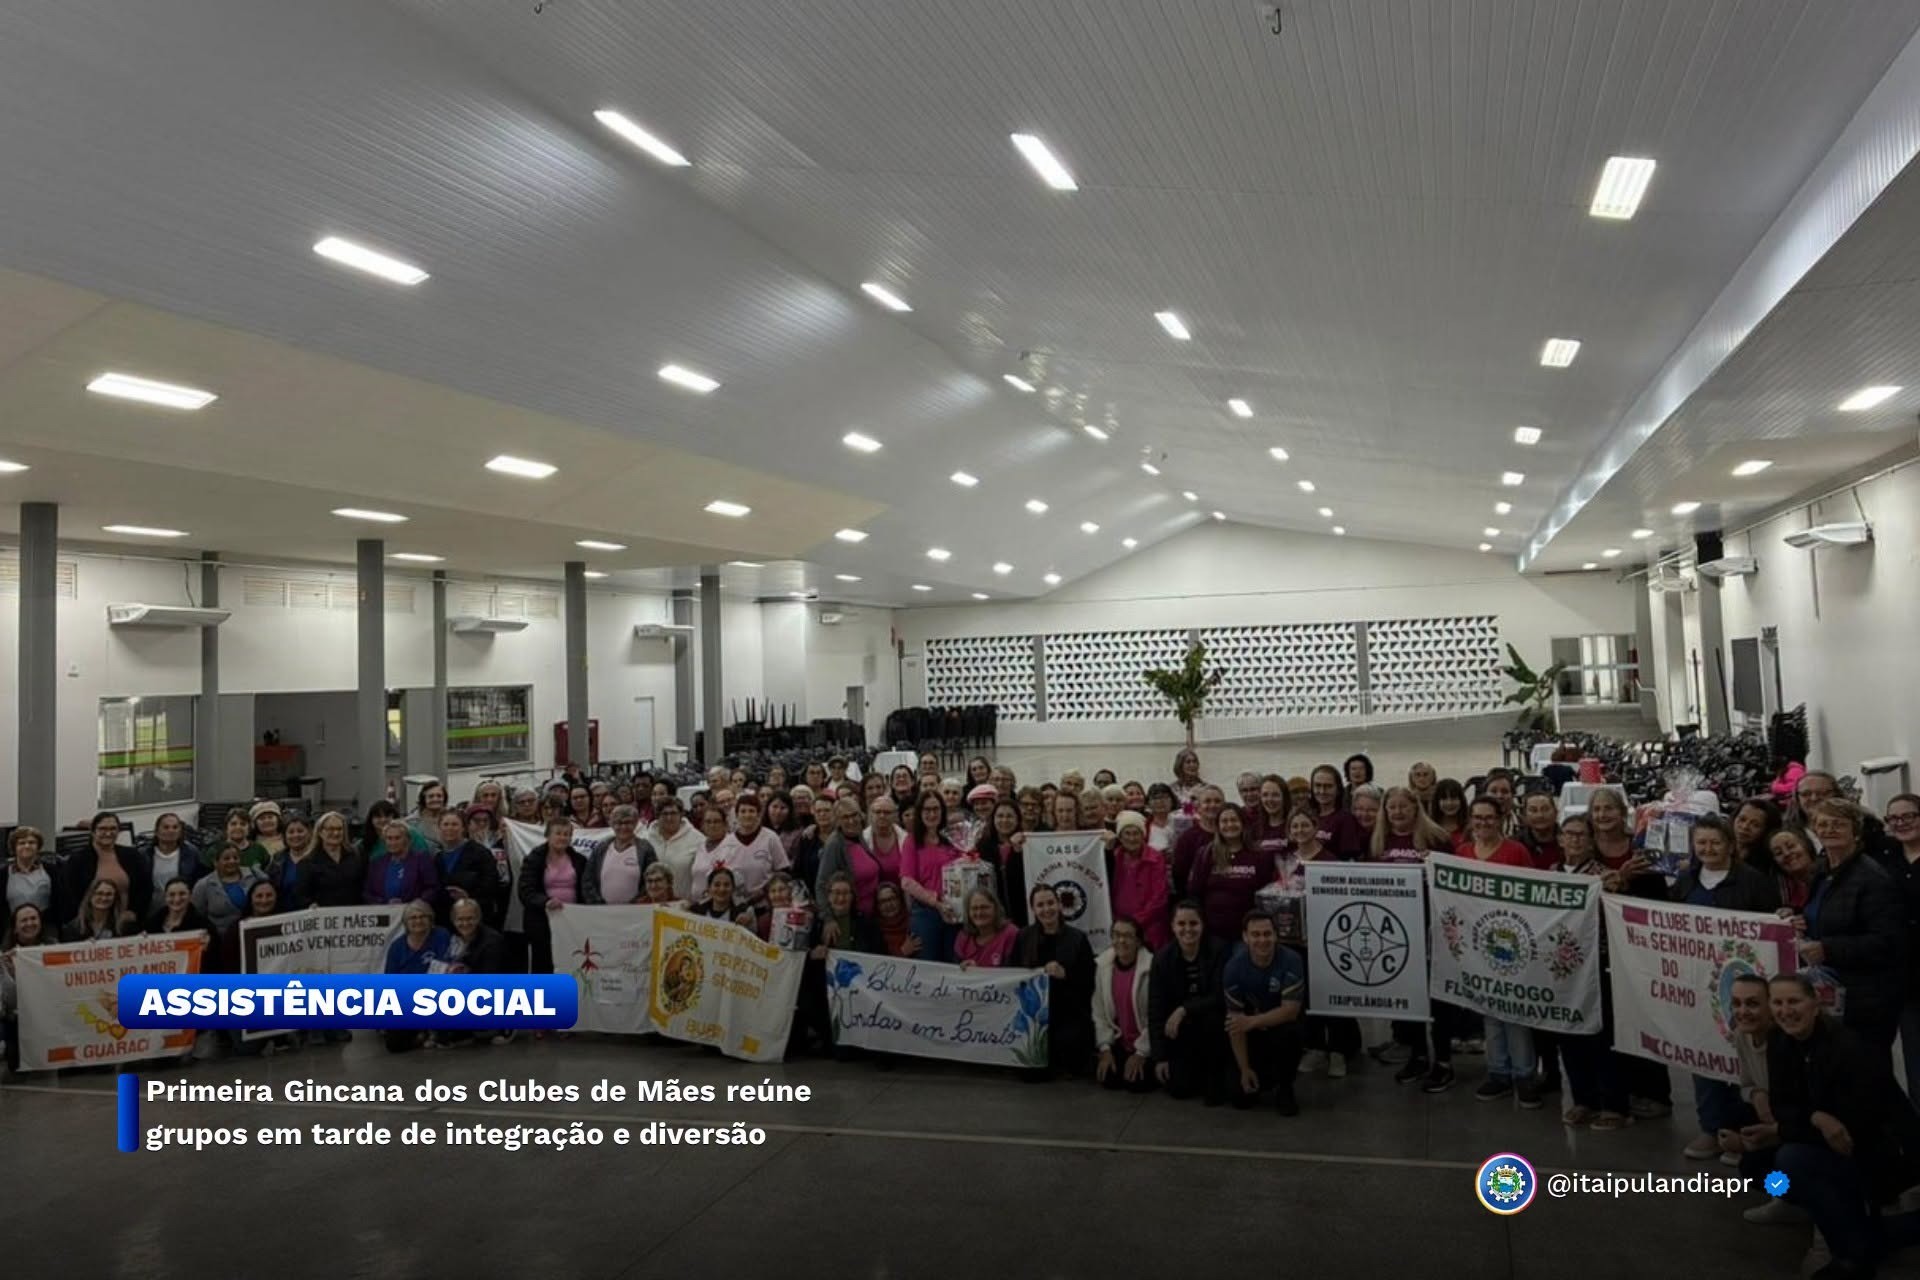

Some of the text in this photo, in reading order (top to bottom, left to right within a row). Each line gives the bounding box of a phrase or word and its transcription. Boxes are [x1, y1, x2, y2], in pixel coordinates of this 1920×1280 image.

[1436, 868, 1585, 907] CLUBE DE MÃES
[284, 914, 377, 936] CLUBE DE MÃES
[1338, 914, 1395, 934] O A
[1651, 911, 1759, 940] CLUBE DE MÃES
[73, 948, 113, 964] CLUBE
[118, 945, 133, 959] DE
[259, 933, 385, 960] UNIDAS VENCEREMOS
[1651, 932, 1717, 961] SENHORA
[64, 970, 115, 988] UNIDAS
[142, 961, 177, 975] AMOR
[1340, 953, 1395, 973] S C
[1662, 958, 1678, 978] DO
[867, 961, 921, 996] Clube
[957, 984, 1011, 1005] mães
[1461, 971, 1554, 1003] BOTAFOGO
[1651, 980, 1696, 1007] CARMO
[1487, 997, 1584, 1023] PRIMAVERA
[912, 1022, 945, 1039] em
